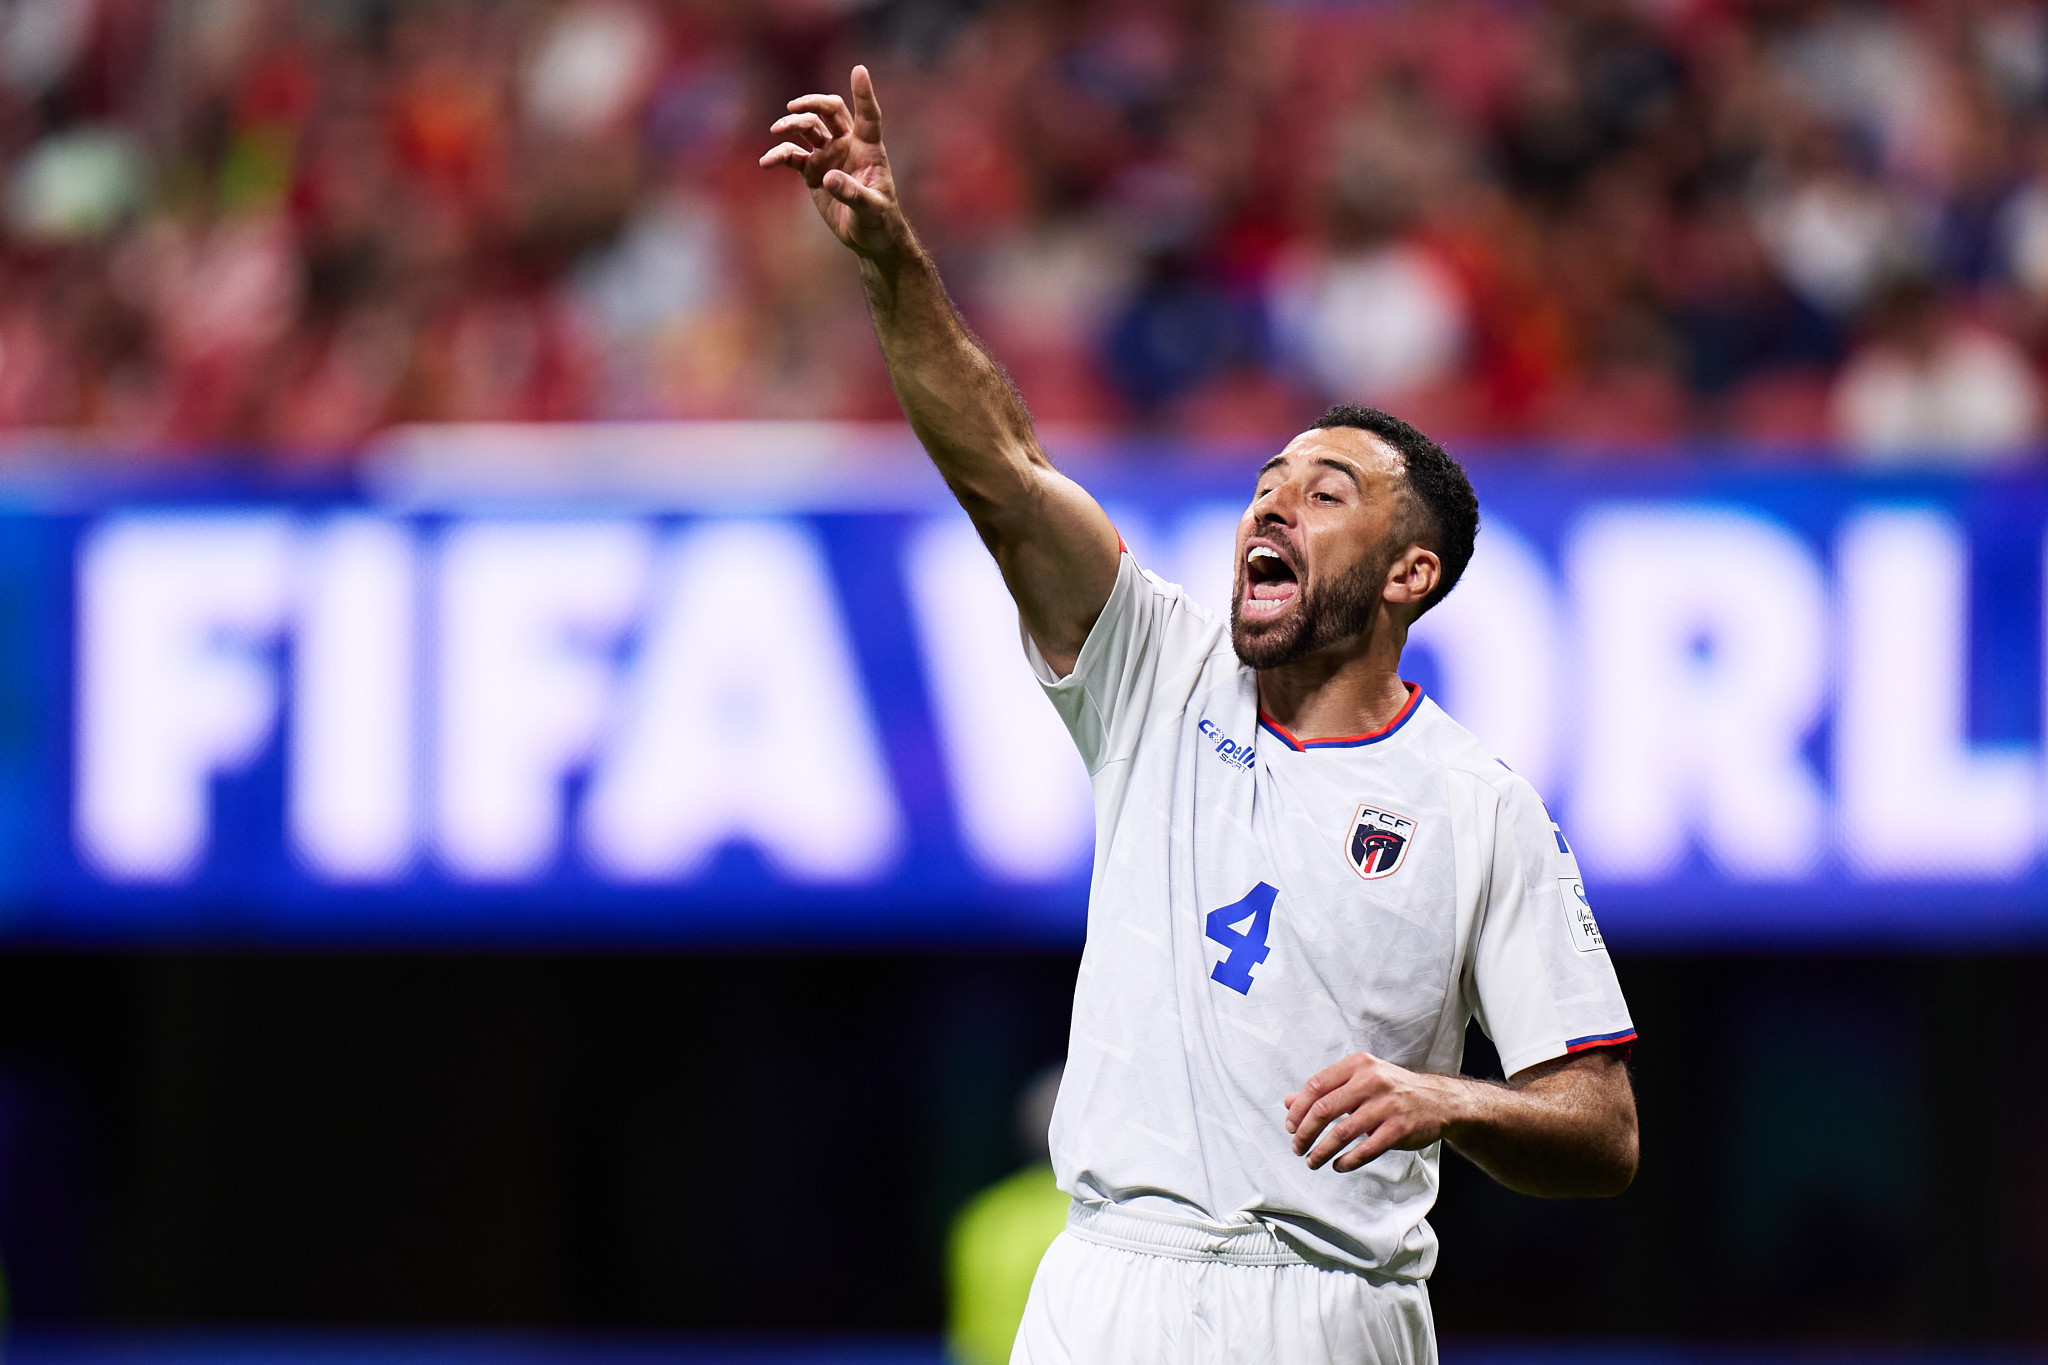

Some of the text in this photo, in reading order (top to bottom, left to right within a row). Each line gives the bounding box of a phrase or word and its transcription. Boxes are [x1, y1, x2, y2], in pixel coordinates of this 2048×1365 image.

[74, 510, 906, 882] FIFA
[1362, 808, 1412, 828] FCF
[1205, 880, 1280, 996] 4
